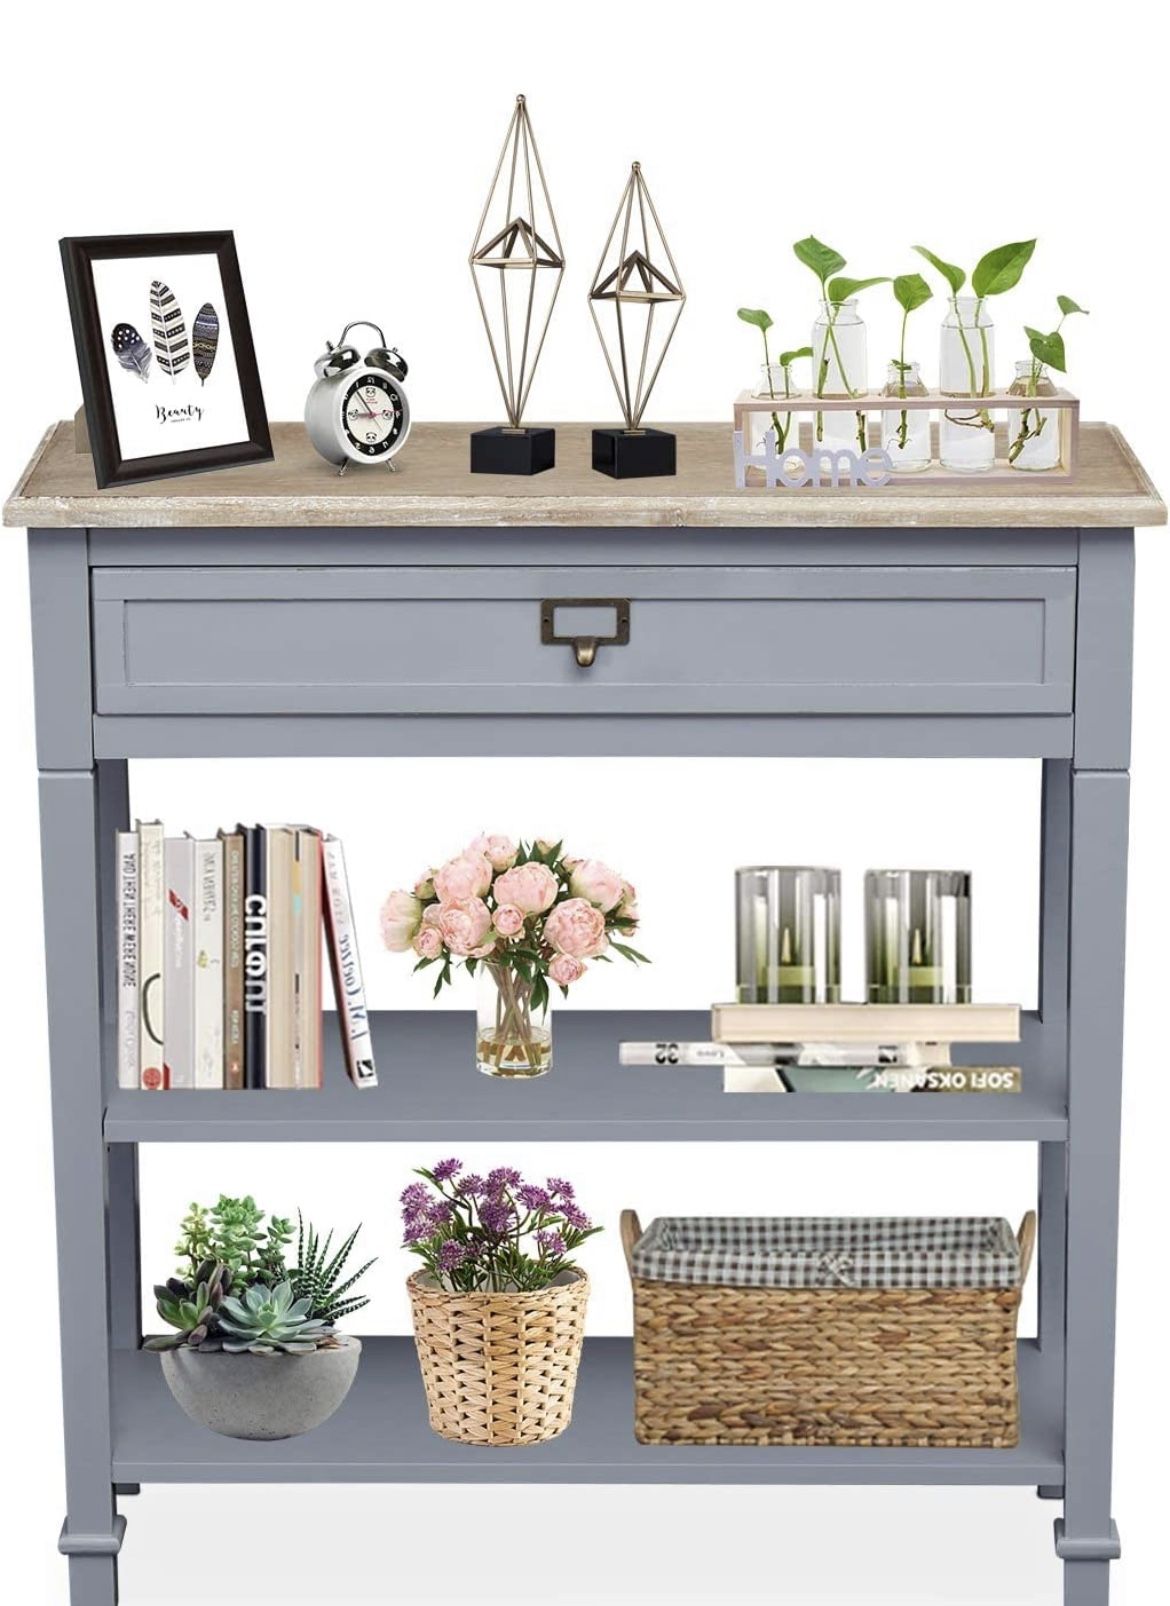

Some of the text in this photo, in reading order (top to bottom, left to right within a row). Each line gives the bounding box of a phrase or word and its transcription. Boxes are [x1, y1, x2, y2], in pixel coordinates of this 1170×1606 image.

[155, 403, 205, 425] Beauty
[734, 431, 893, 488] Home
[655, 1043, 679, 1064] 32
[872, 1071, 1014, 1090] SOFI OKSANEN
